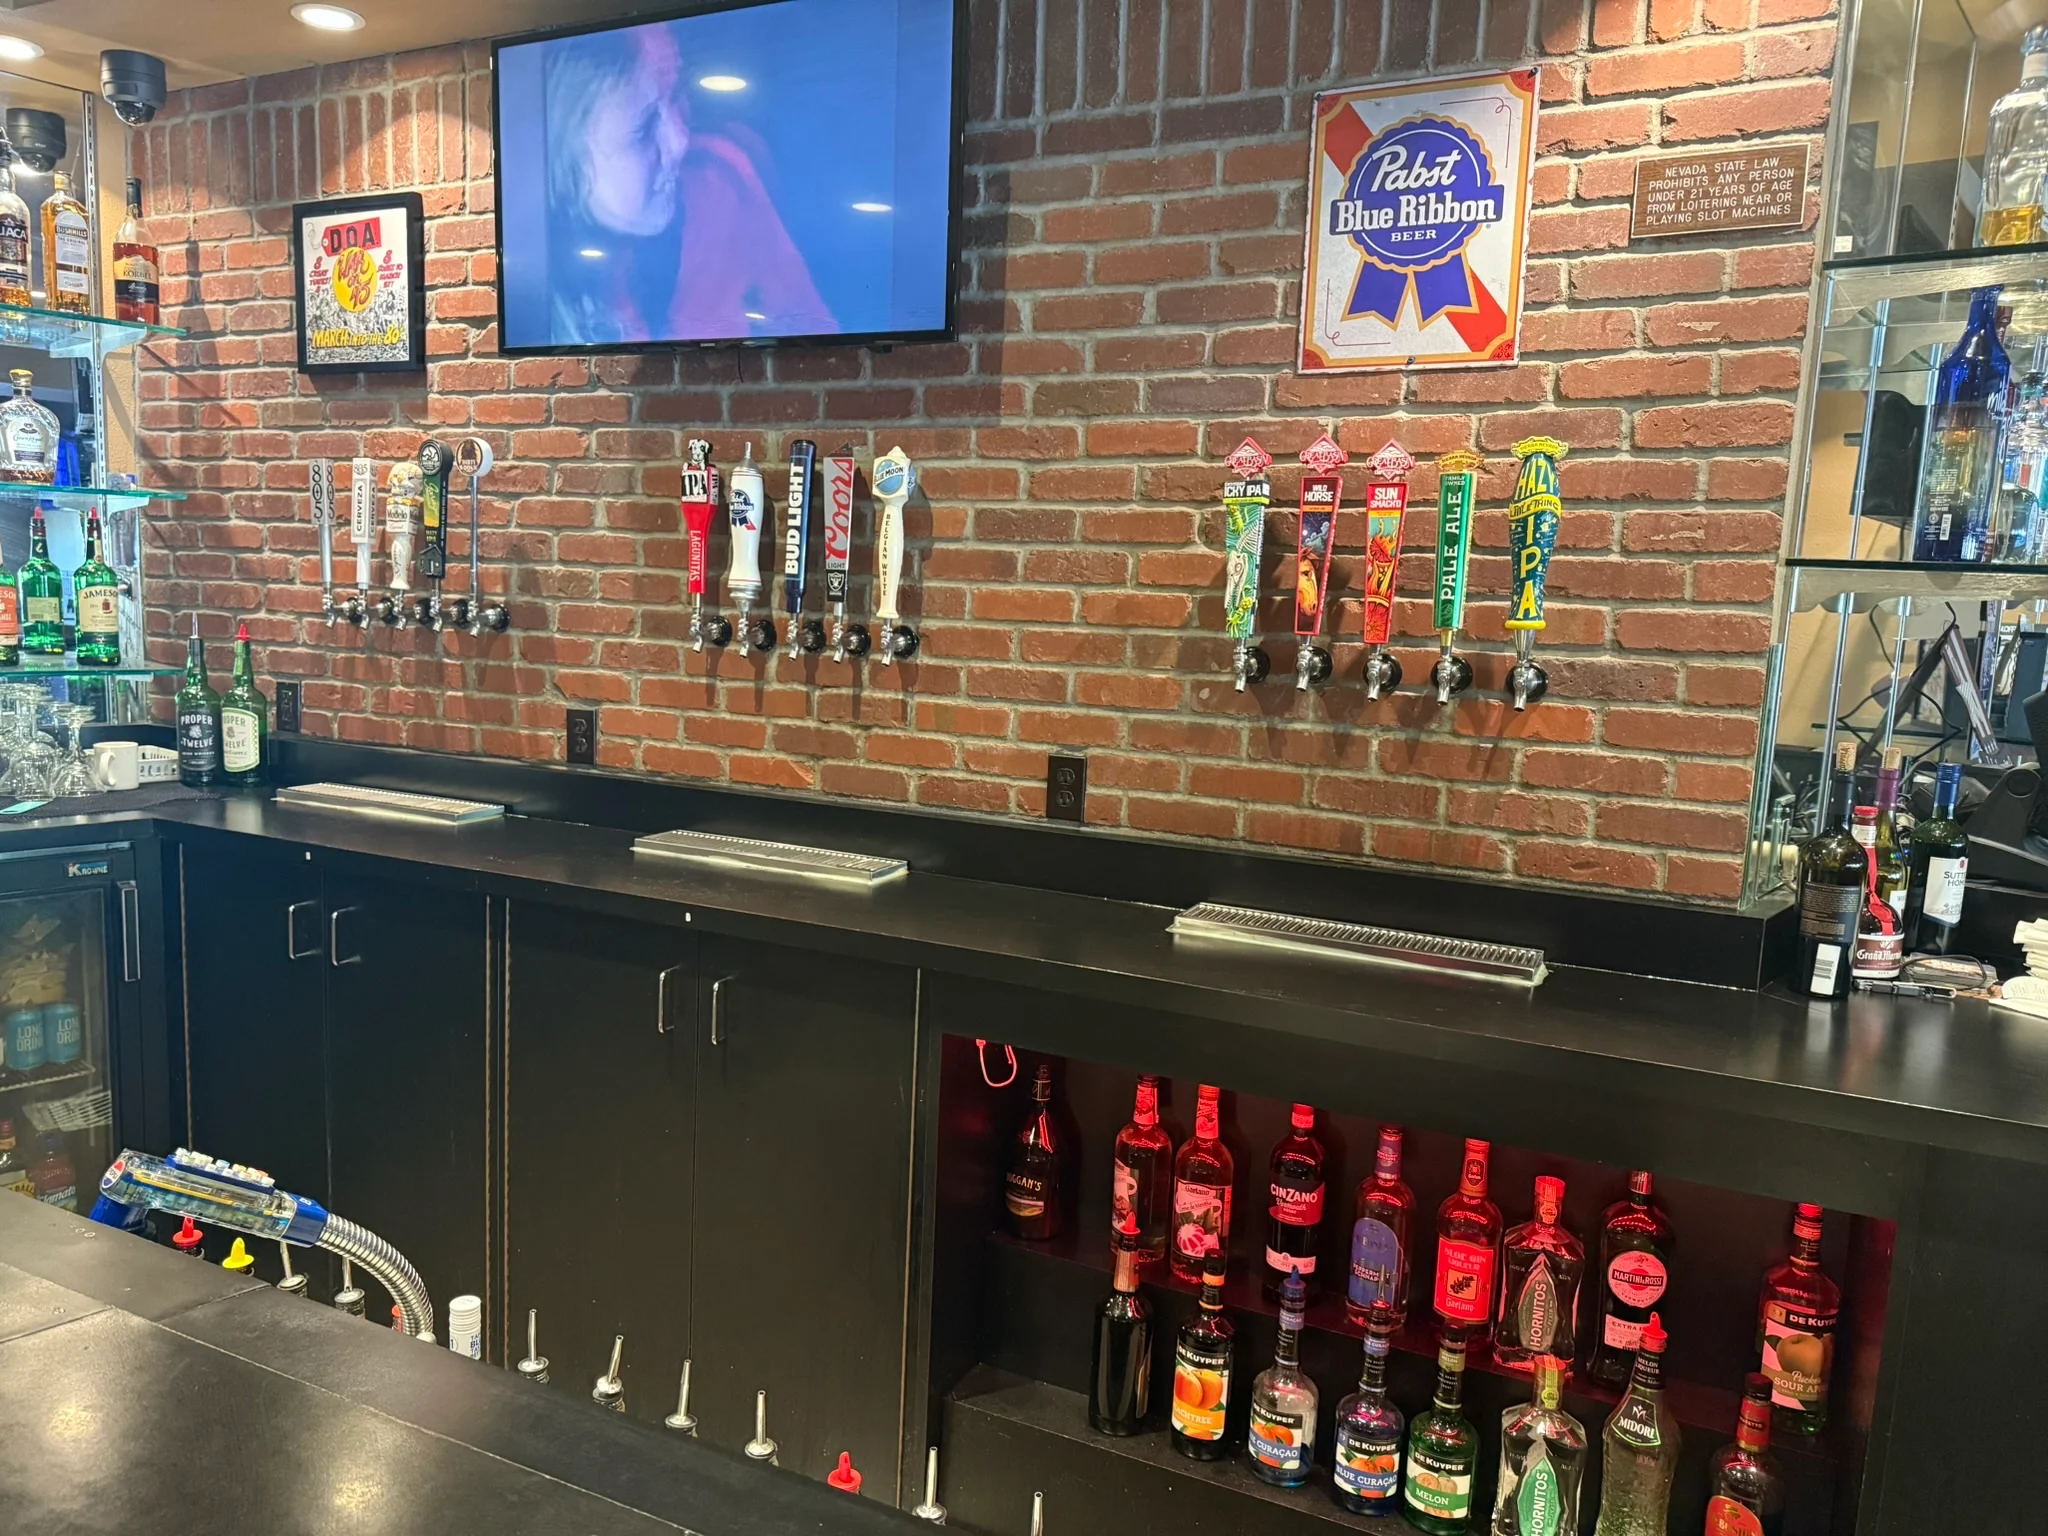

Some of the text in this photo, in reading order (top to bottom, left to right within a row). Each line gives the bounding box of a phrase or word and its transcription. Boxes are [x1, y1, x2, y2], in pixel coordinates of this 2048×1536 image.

[1370, 145, 1462, 192] Pabst
[1665, 157, 1780, 178] NEVADA STATE LAW
[1649, 168, 1795, 191] PROHIBITS ANY PERSON
[1648, 180, 1793, 203] UNDER 21 YEARS OF AGE
[1335, 191, 1496, 232] Blue Ribbon
[1647, 192, 1792, 214] FROM LOITERING NEAR OR
[1646, 204, 1791, 226] PLAYING SLOT MACHINES
[57, 225, 88, 238] BUSHMILLS
[1391, 229, 1437, 242] BEER
[123, 269, 152, 279] KORBEL
[313, 329, 347, 349] MARCH
[885, 466, 904, 477] MOON
[1514, 458, 1555, 500] HAZY
[312, 464, 323, 520] 805
[682, 474, 709, 497] IPA
[1224, 485, 1262, 498] ICKY IPA
[1375, 487, 1398, 500] SUN
[1304, 492, 1334, 502] HORSE
[825, 458, 853, 560] Coors
[785, 463, 805, 575] BUD LIGHT
[883, 513, 891, 560] BELGIAN
[1441, 492, 1462, 600] PALE ALE
[690, 530, 701, 582] LAGUNITAS
[1517, 515, 1541, 618] IPA
[181, 714, 213, 726] PROPER
[182, 736, 214, 748] TWELVE
[1944, 870, 1967, 880] SUTT
[58, 1017, 78, 1032] LON
[17, 1037, 43, 1051] DRIN
[1006, 1172, 1042, 1191] UGGAN'S
[1271, 1183, 1318, 1203] CINZANO
[1447, 1259, 1480, 1271] LIQUEUR
[1469, 1254, 1487, 1264] GIN
[1353, 1263, 1390, 1279] PEPPERMT
[1355, 1270, 1380, 1282] SCHNAP
[1445, 1298, 1474, 1313] Gaetano
[1530, 1283, 1547, 1347] HORNITOS
[1611, 1321, 1638, 1331] EXTRA
[1789, 1315, 1836, 1328] DE KUYP
[1187, 1350, 1225, 1366] KUYPER
[1637, 1357, 1659, 1367] MELON
[1774, 1376, 1804, 1393] SOUR
[1261, 1409, 1295, 1424] KUYPER
[1618, 1416, 1656, 1439] MIDORI
[1257, 1438, 1298, 1459] CURAÇAO
[1349, 1439, 1396, 1452] DE KUYPER
[1415, 1451, 1464, 1471] DE KUYPER
[1335, 1465, 1397, 1488] BLUE CURAÇAO
[1415, 1487, 1449, 1506] MELON
[1531, 1472, 1548, 1536] HORNITOS
